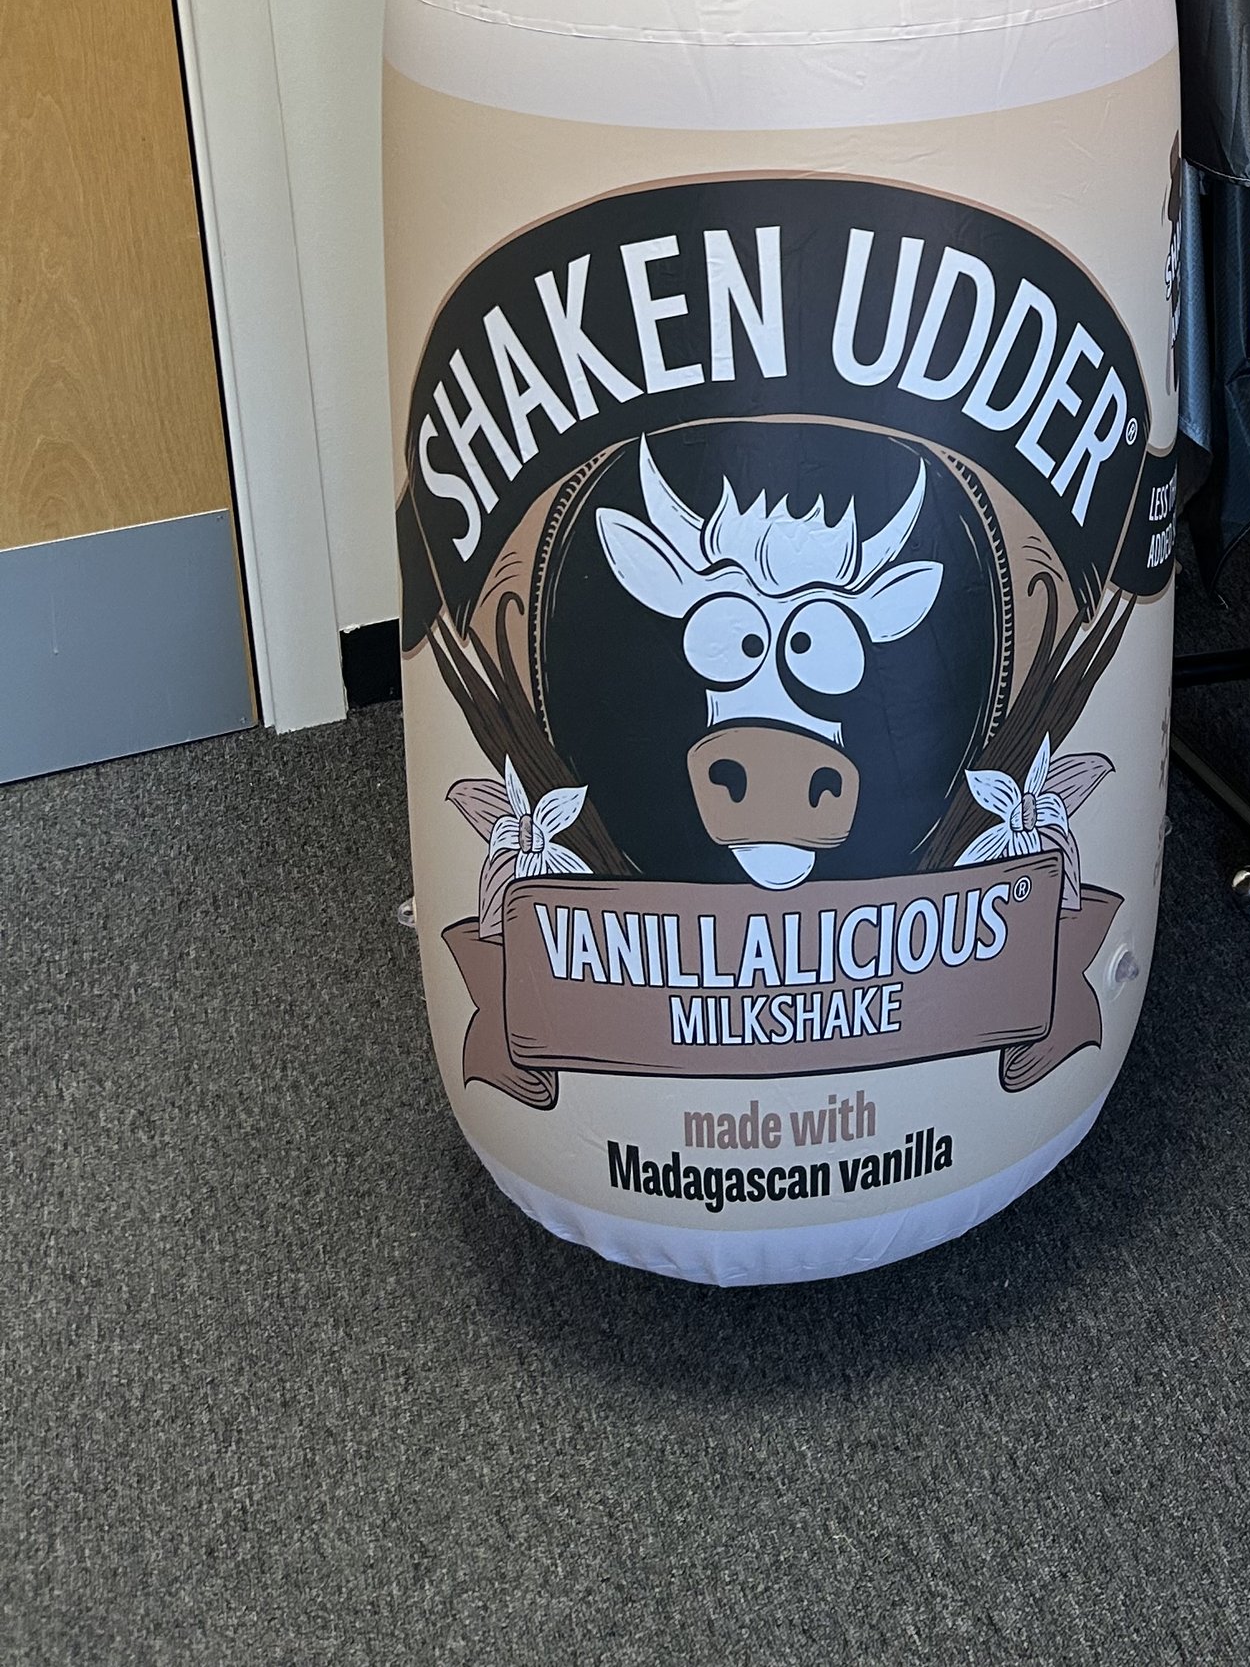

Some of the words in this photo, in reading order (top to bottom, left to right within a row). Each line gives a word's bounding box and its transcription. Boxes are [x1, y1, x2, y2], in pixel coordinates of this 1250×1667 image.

[419, 225, 787, 562] SHAKEN
[1148, 484, 1169, 521] LESS
[669, 983, 904, 1046] MILKSHAKE
[683, 1101, 781, 1150] made
[790, 1090, 877, 1144] with
[606, 1140, 832, 1214] Madagascan
[838, 1127, 954, 1194] vanilla
